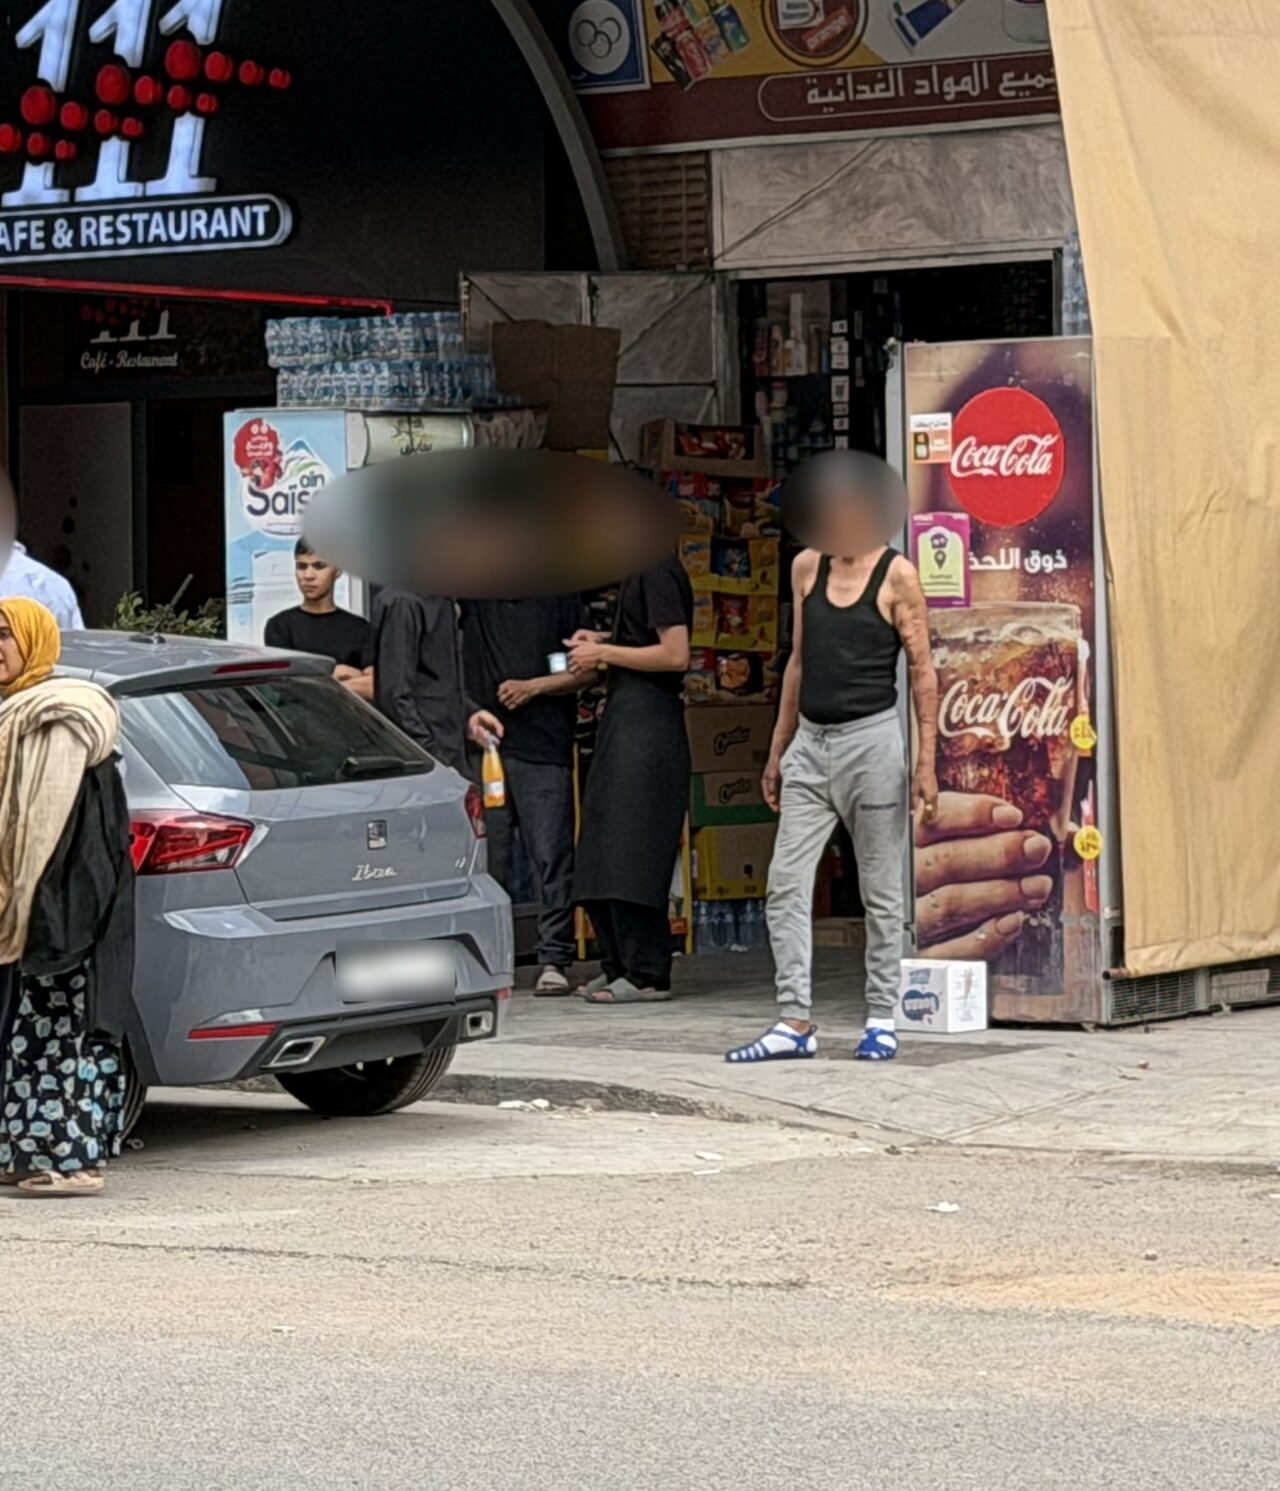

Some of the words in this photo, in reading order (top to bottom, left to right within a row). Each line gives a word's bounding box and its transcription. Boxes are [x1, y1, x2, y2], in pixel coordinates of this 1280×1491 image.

[914, 61, 989, 101] المواد
[999, 66, 1056, 98] ميع
[52, 218, 73, 249] &
[80, 205, 270, 247] RESTAURANT
[81, 350, 108, 374] Café
[950, 433, 1060, 478] Coca-Cola
[299, 470, 325, 489] ain
[246, 483, 310, 517] Saïs
[1024, 548, 1068, 574] ذوق
[938, 676, 1074, 752] Coca-Cola
